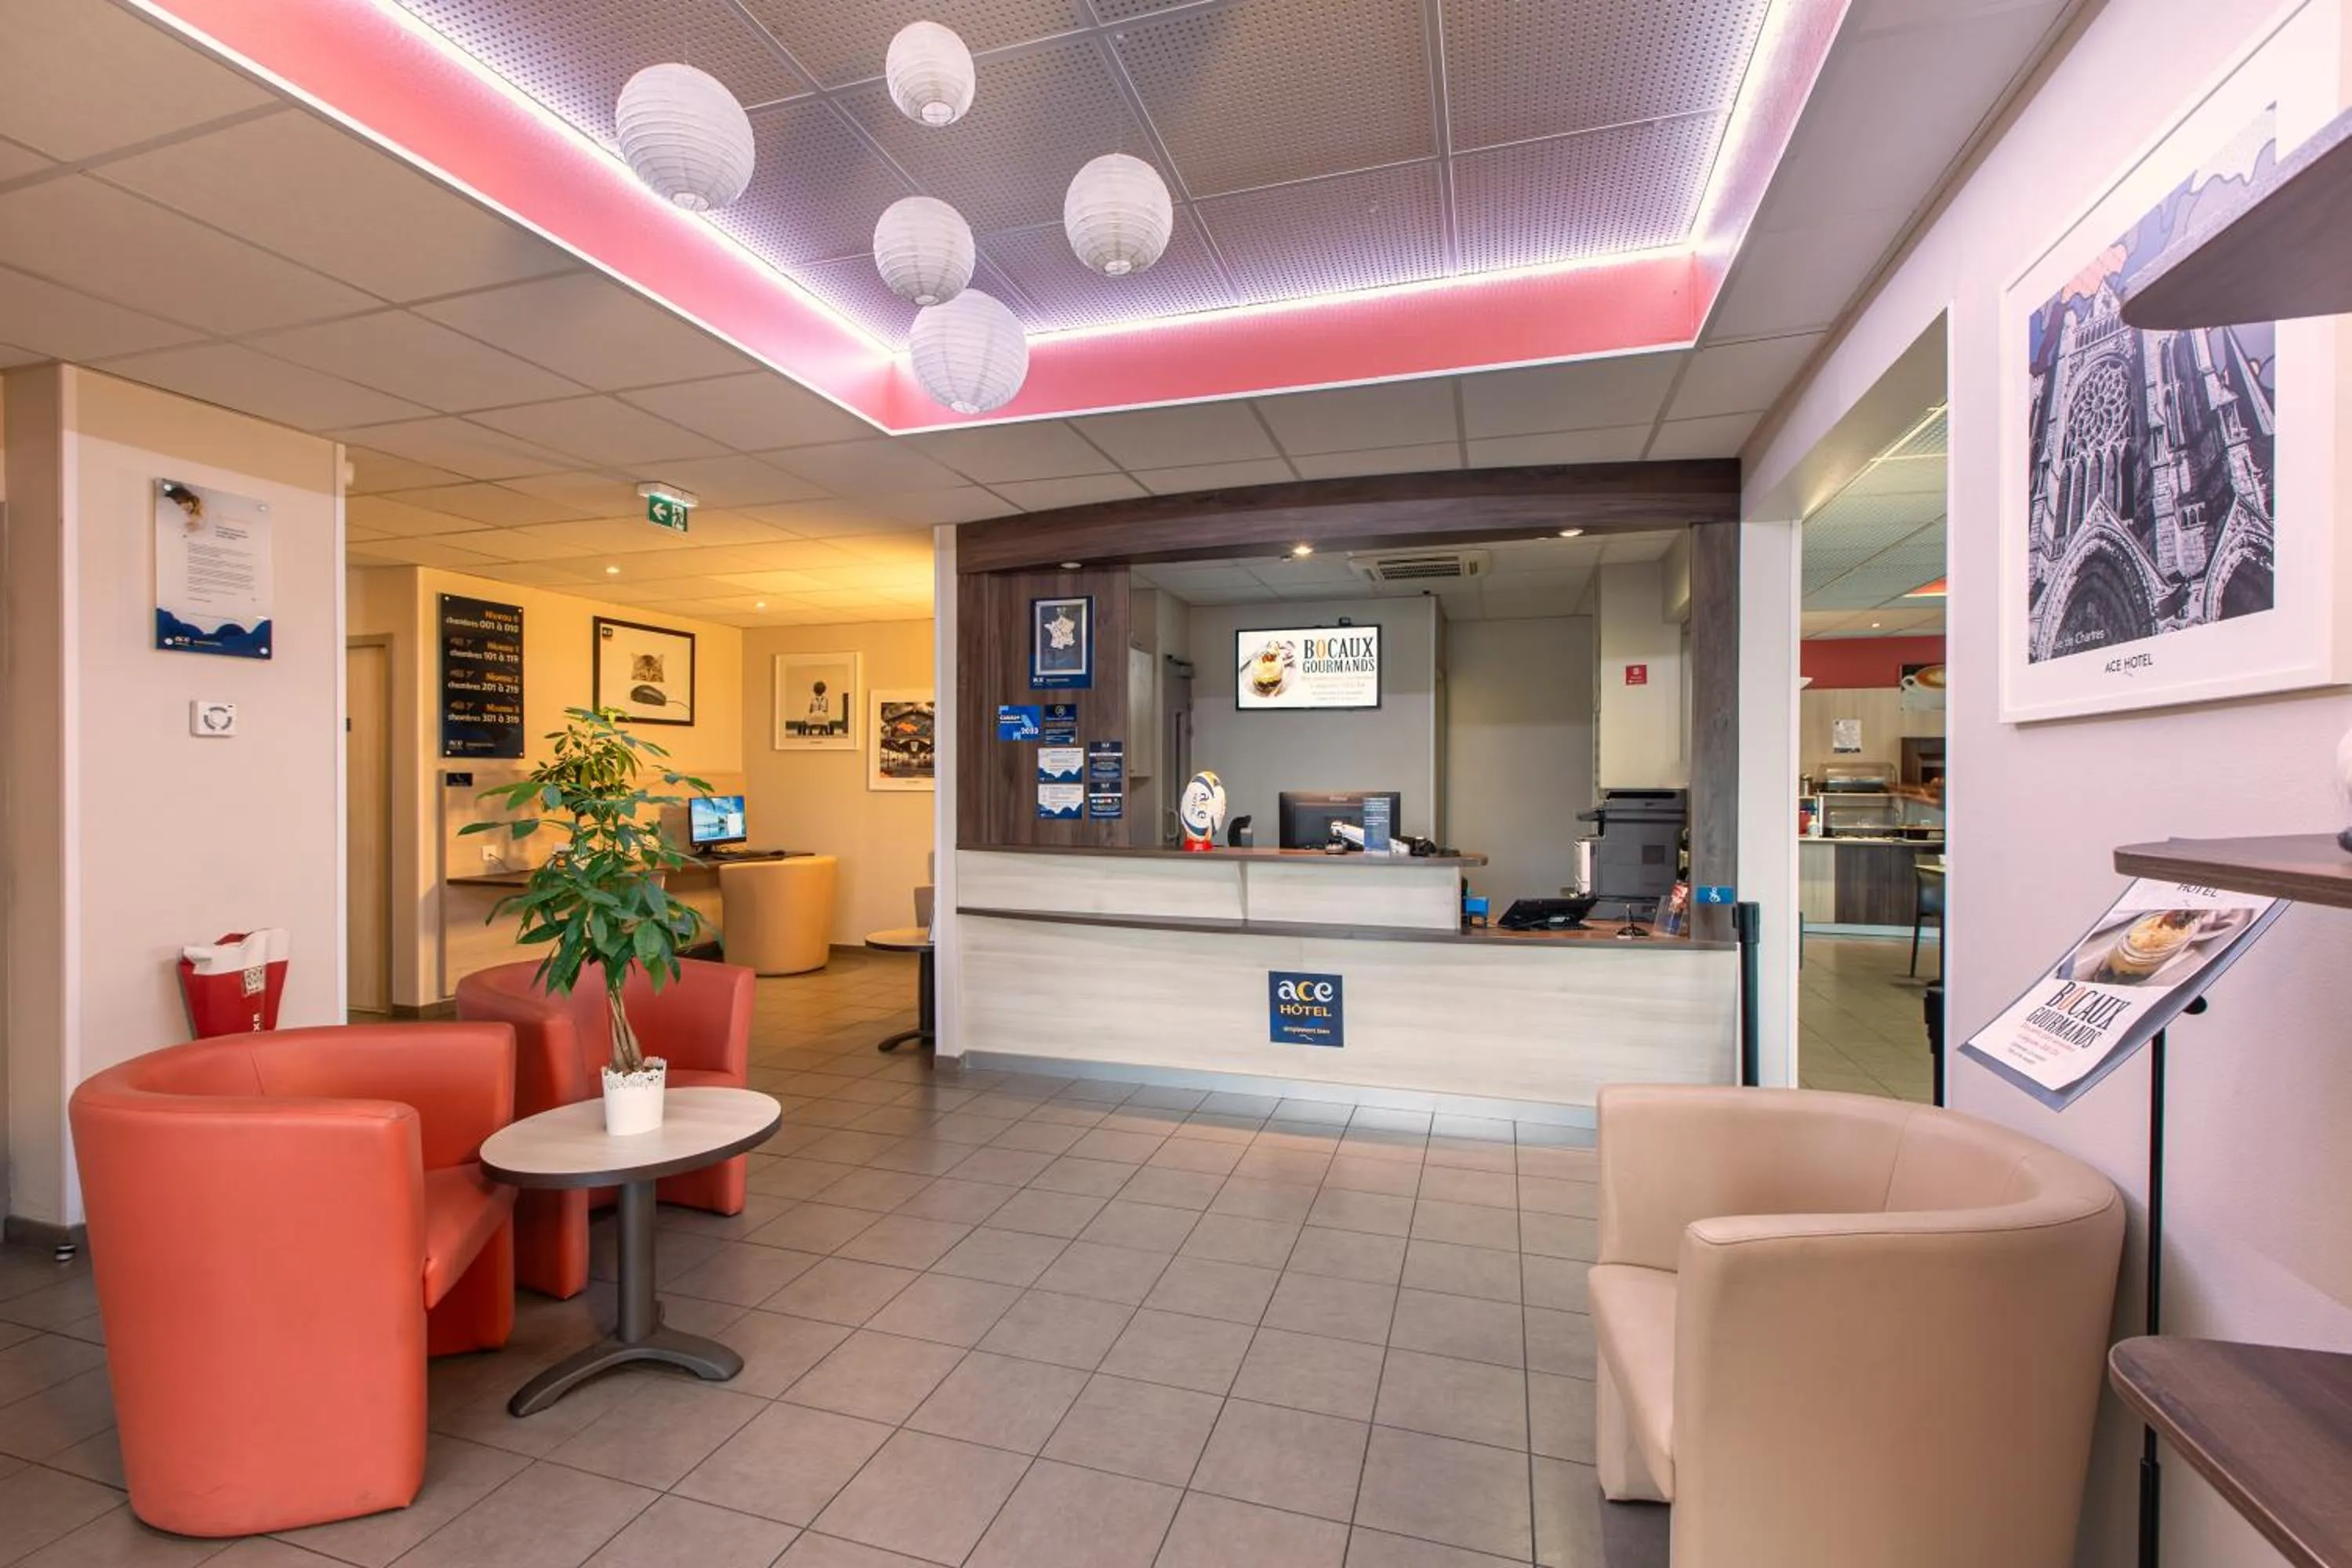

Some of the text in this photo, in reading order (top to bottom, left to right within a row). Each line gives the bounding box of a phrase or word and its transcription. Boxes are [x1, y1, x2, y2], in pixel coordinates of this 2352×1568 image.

[480, 620, 495, 630] 001
[1304, 637, 1374, 659] BOCAUX
[484, 652, 497, 662] 101
[2105, 653, 2154, 673] ACE HOTEL
[1302, 658, 1375, 673] GOURMANDS
[481, 681, 496, 691] 201
[498, 682, 503, 692] à
[481, 713, 496, 722] 301
[1278, 980, 1333, 1002] ace
[1279, 1003, 1332, 1017] HÔTEL
[2045, 982, 2131, 1030] BOCAUX
[2026, 1006, 2102, 1049] GOURMANDS
